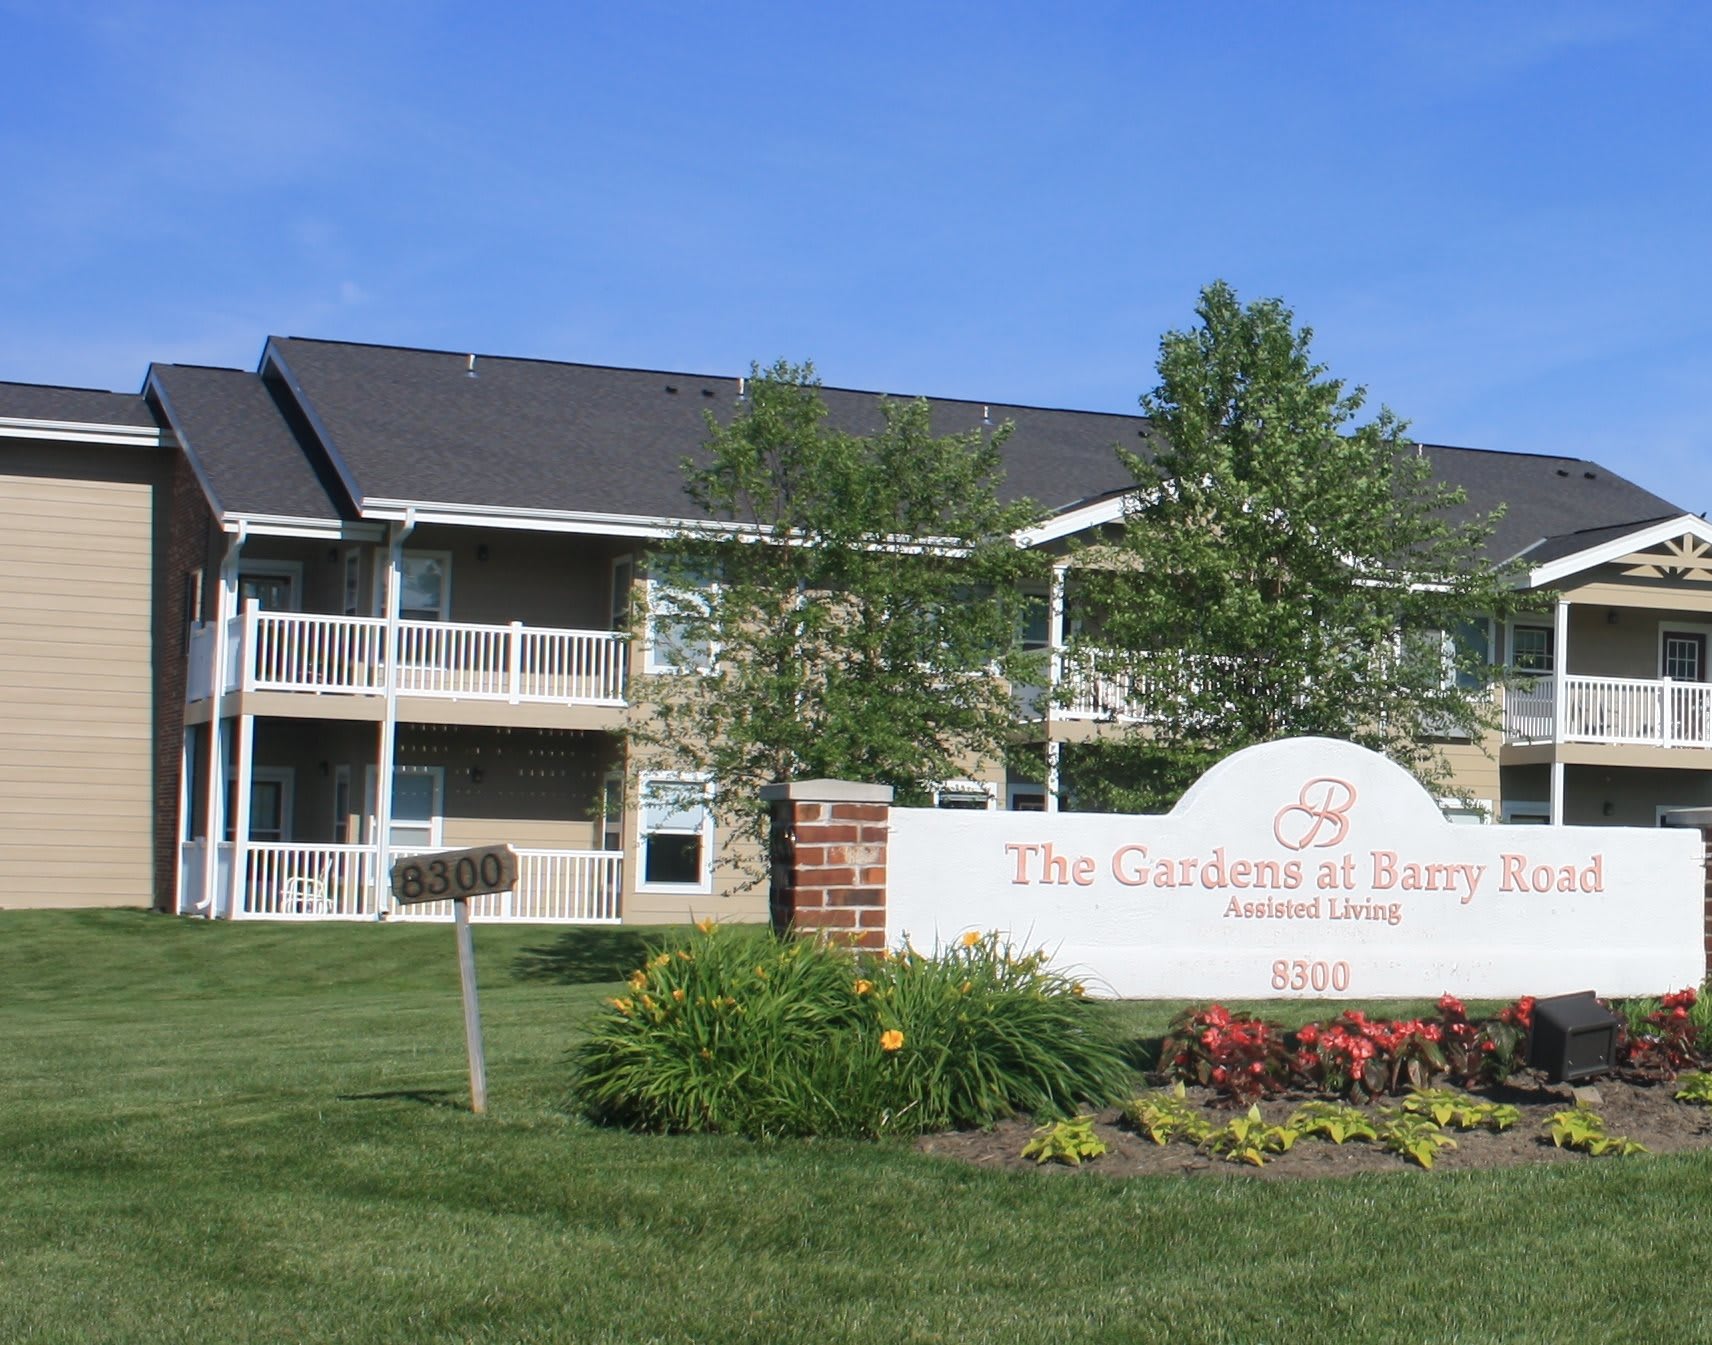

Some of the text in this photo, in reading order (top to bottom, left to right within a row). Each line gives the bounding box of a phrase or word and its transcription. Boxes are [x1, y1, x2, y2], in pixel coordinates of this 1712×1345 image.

[1273, 777, 1358, 850] B
[402, 853, 502, 897] 8300
[1004, 842, 1604, 906] The Gardens at Barry Road
[1223, 895, 1403, 926] Assisted Living
[1270, 959, 1351, 992] 8300
